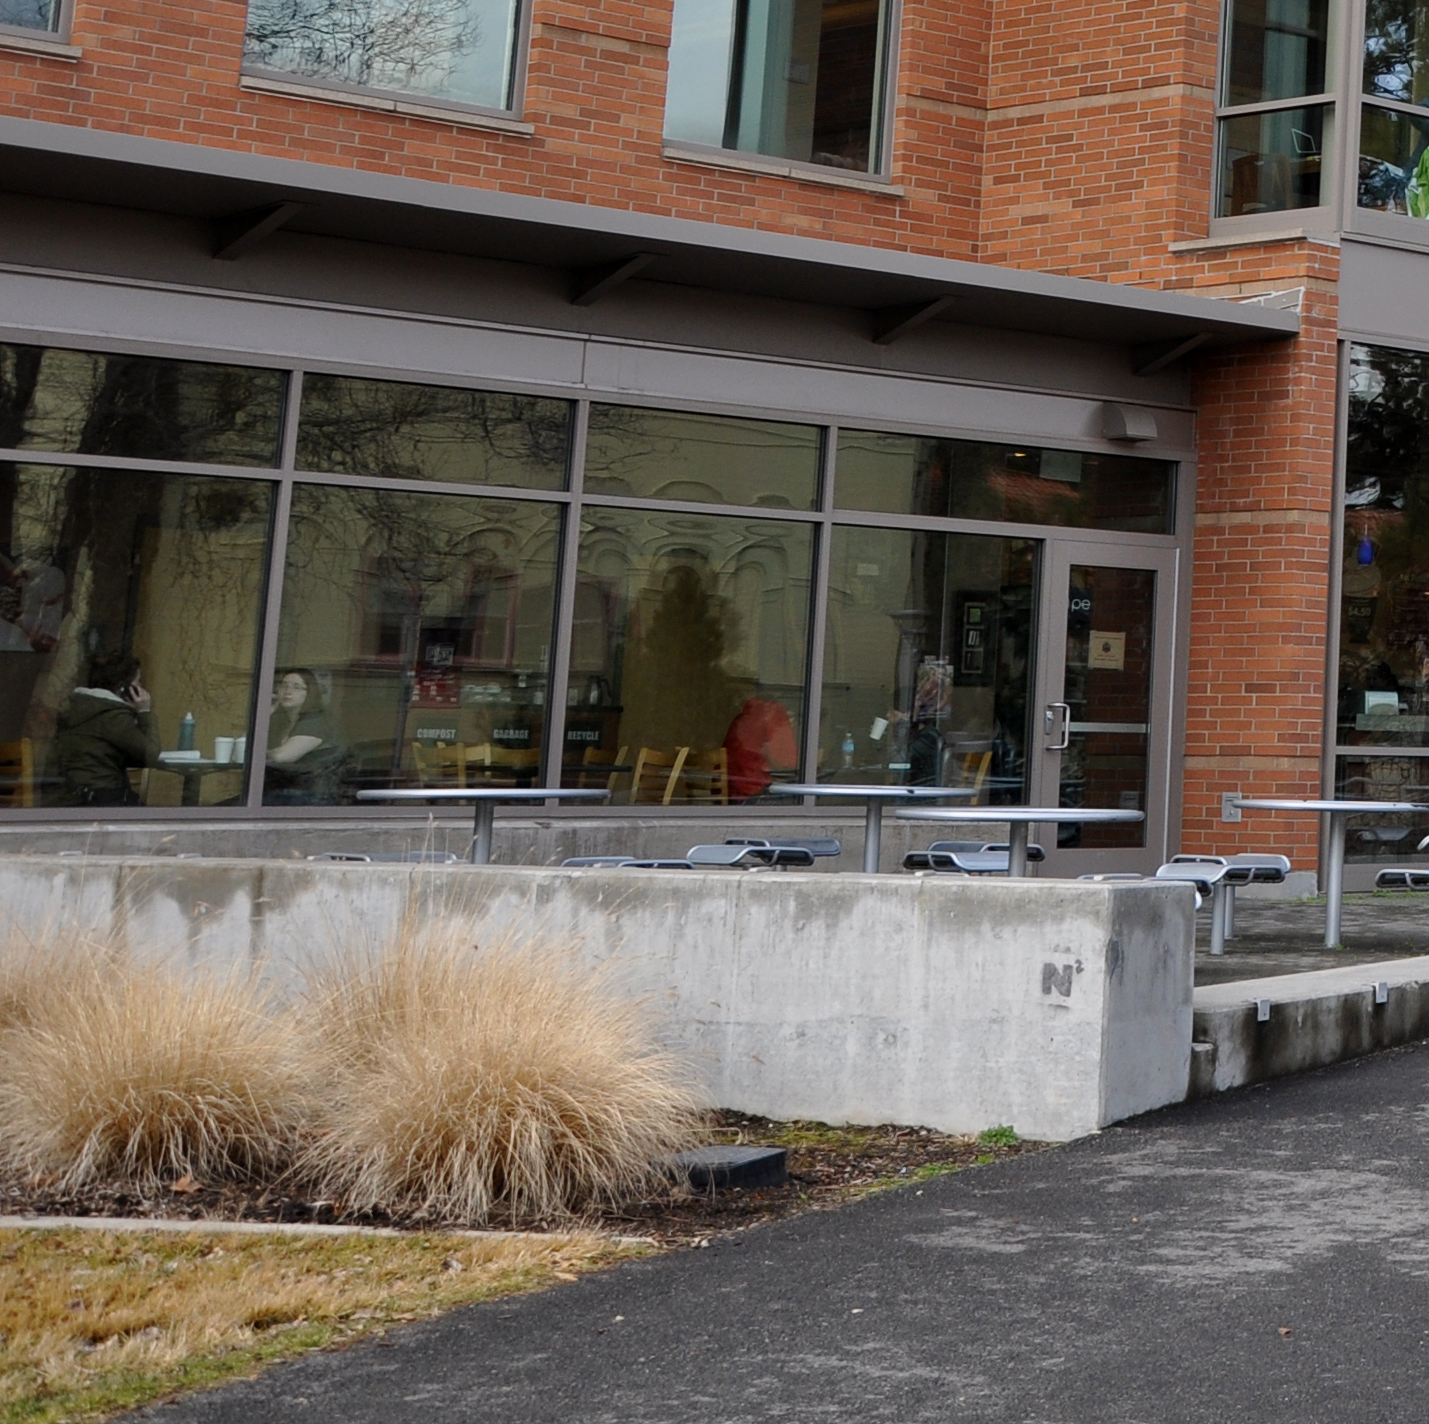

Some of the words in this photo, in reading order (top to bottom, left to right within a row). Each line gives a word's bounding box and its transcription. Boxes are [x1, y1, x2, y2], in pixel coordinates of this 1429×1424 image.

[417, 729, 456, 739] COMPOST
[493, 729, 529, 740] GARBAGE
[567, 731, 599, 741] RECYCLE
